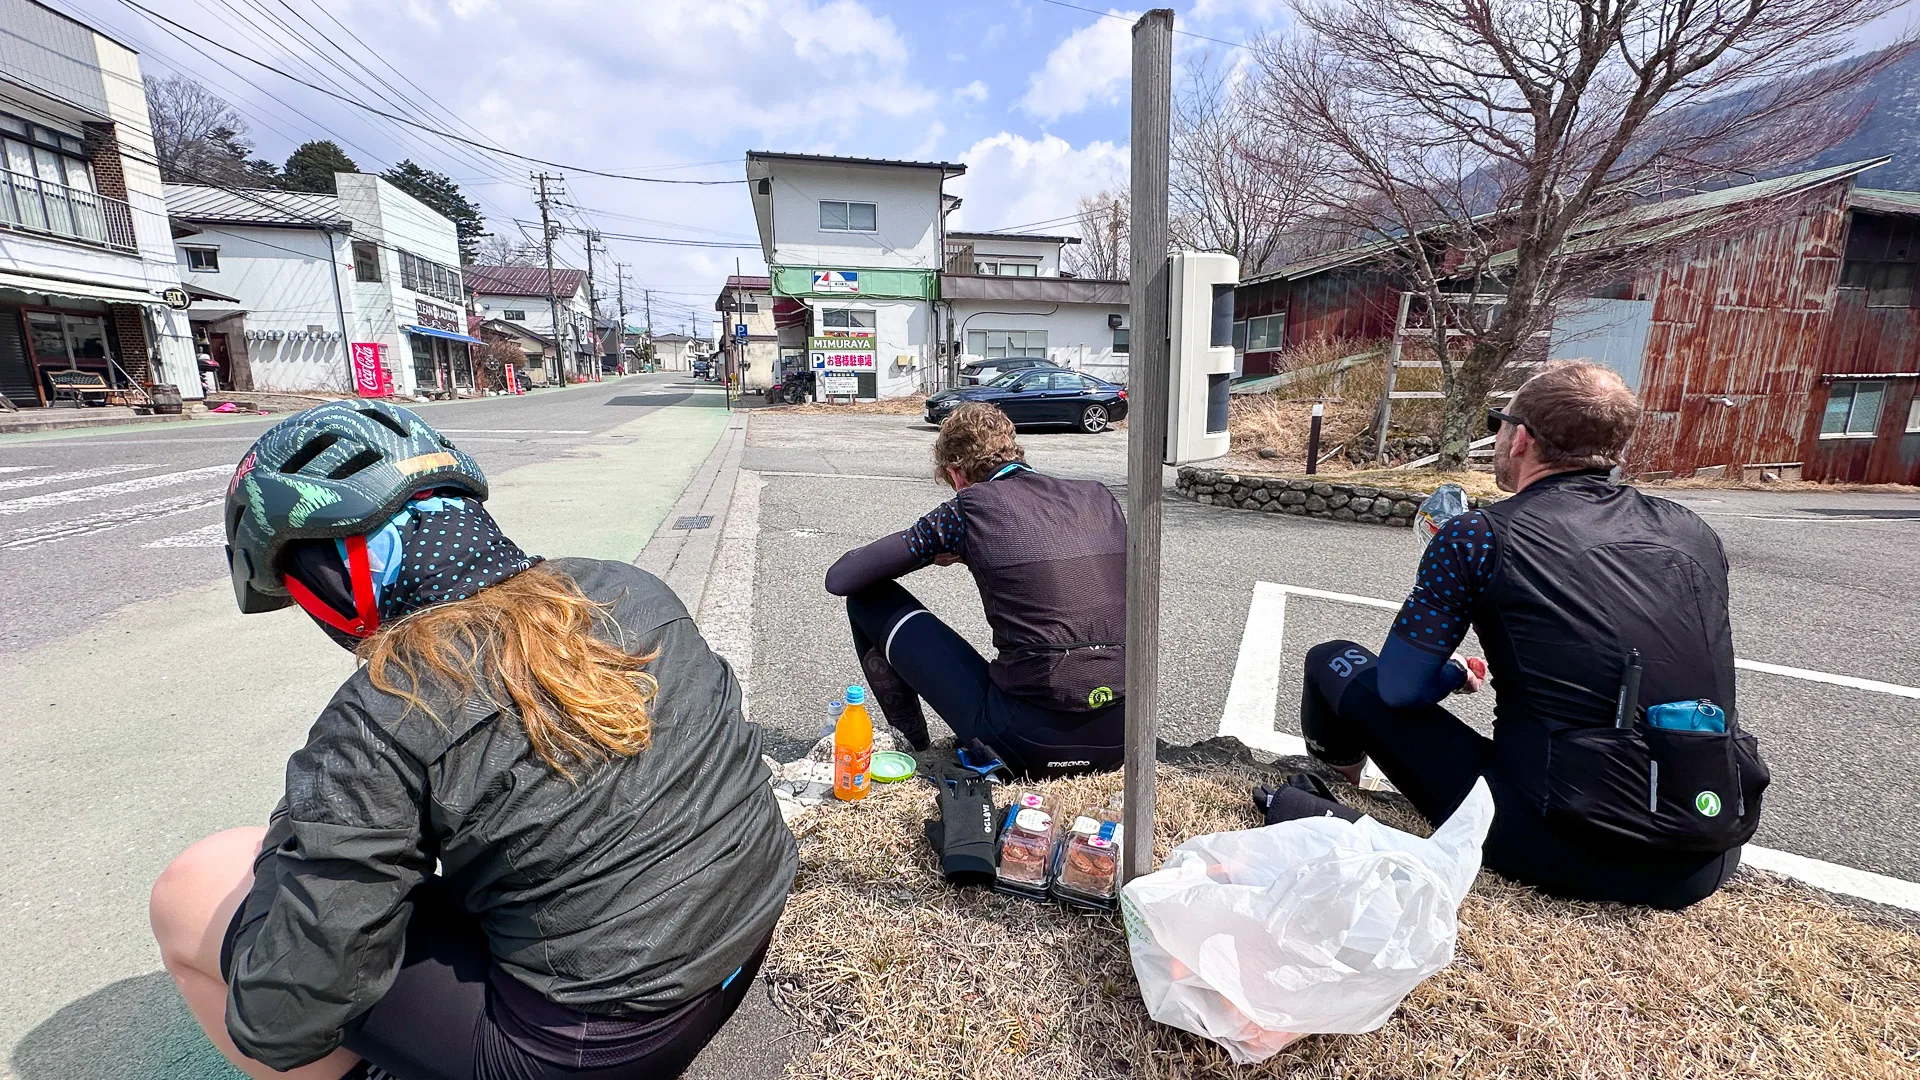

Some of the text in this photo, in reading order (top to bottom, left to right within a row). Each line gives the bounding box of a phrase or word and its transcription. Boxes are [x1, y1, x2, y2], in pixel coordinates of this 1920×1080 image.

[737, 325, 745, 336] P
[814, 339, 871, 349] MIMURAYA
[813, 354, 823, 367] P
[827, 354, 872, 367] お客様駐車場
[1328, 648, 1368, 678] SG
[1047, 760, 1091, 768] ETXEONDO
